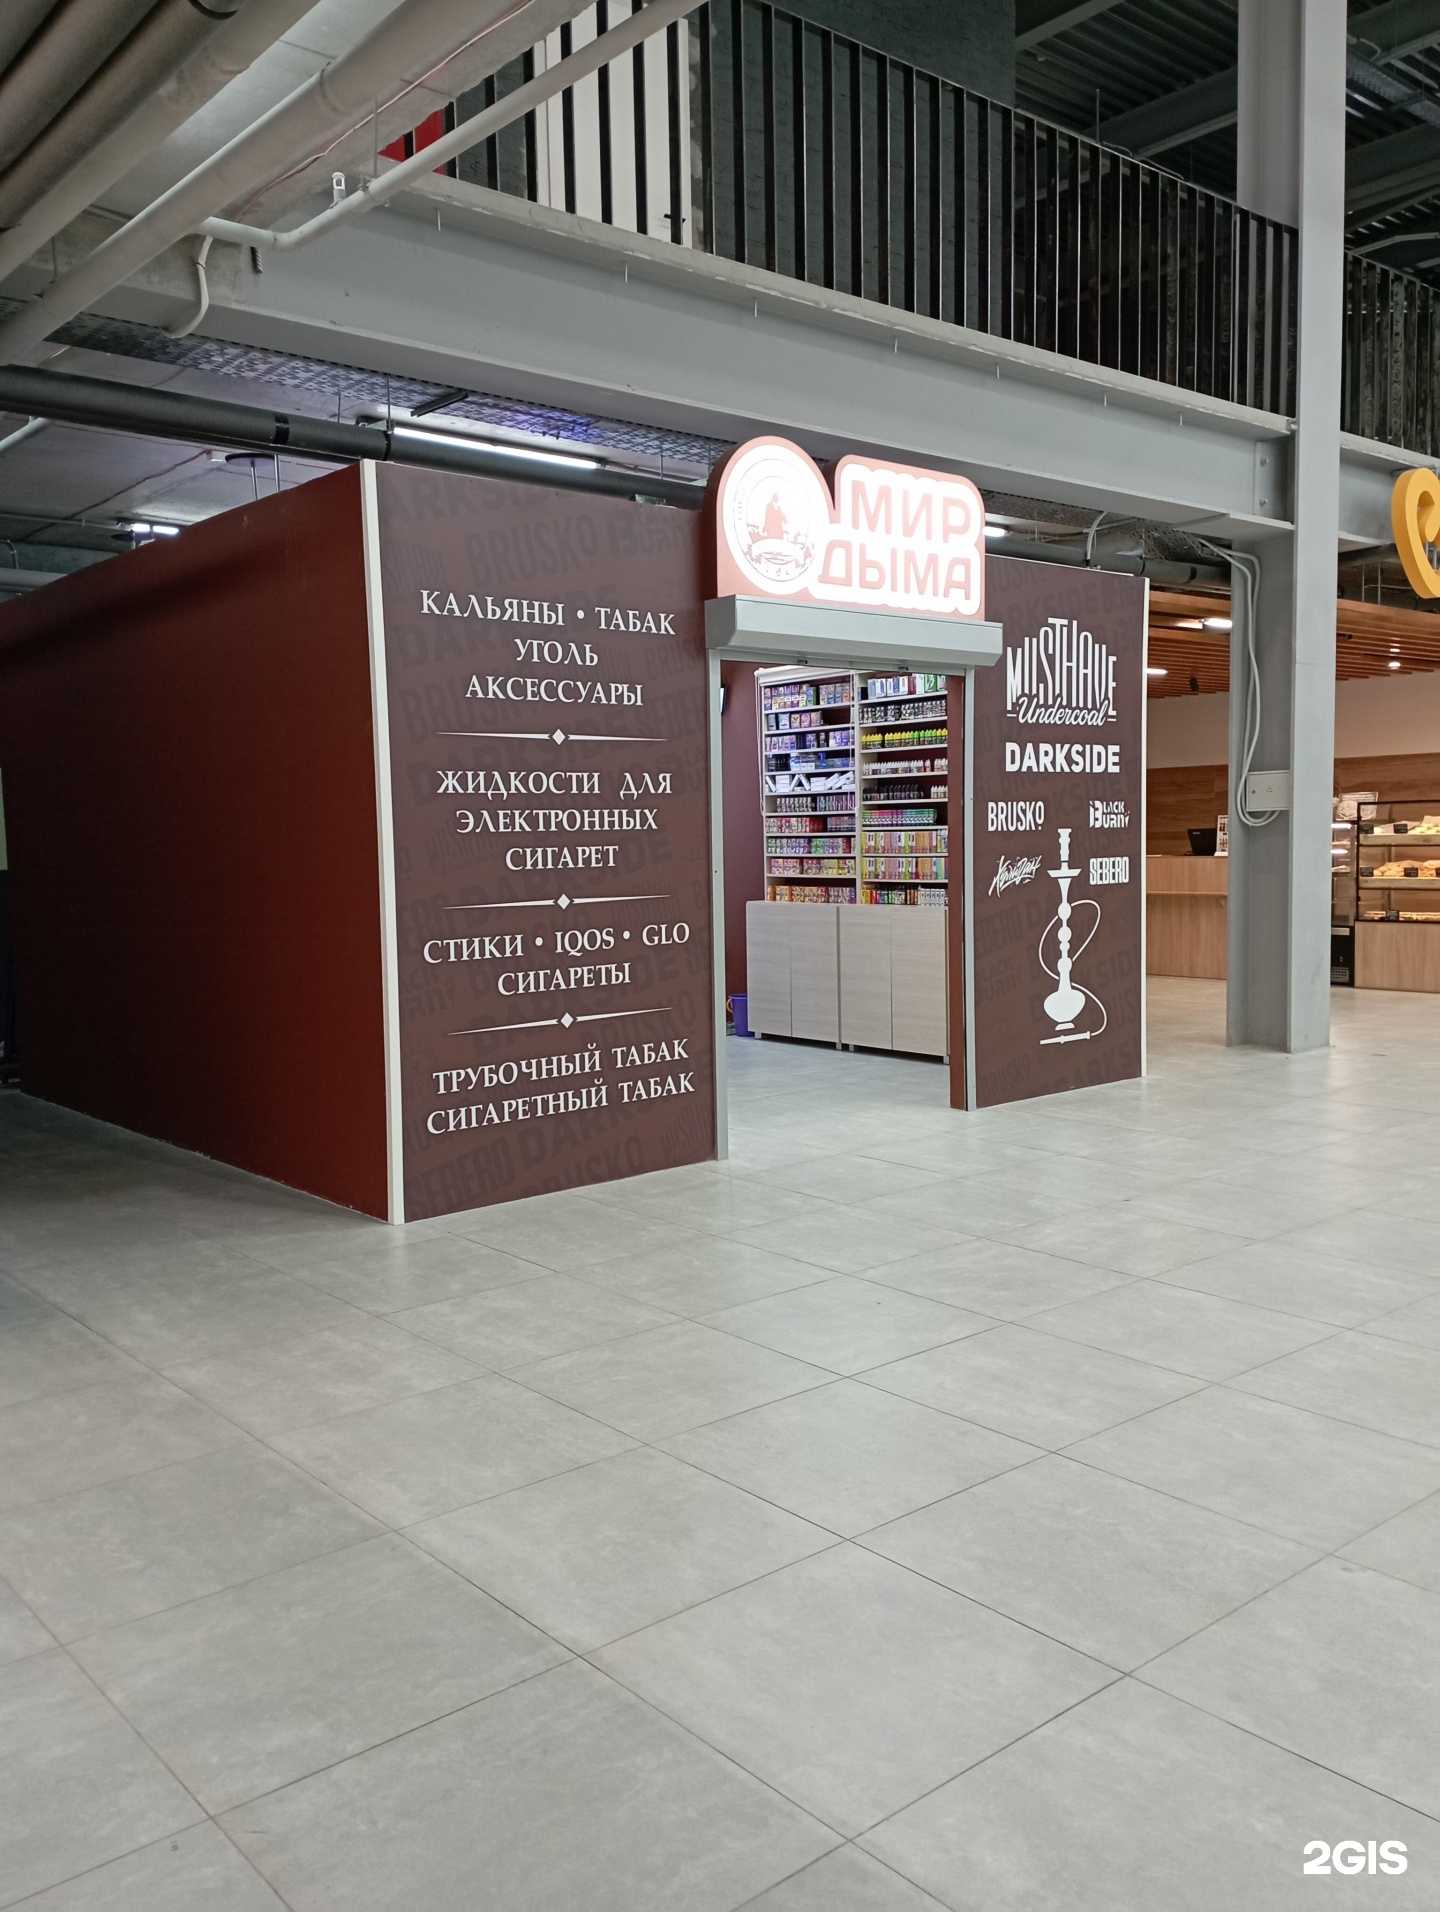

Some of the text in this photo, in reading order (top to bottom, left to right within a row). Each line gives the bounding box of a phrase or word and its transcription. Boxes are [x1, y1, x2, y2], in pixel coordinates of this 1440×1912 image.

[851, 479, 971, 544] МИР
[817, 539, 971, 601] ДЫМА
[421, 590, 675, 634] КАЛЬЯНЫ ТАБАК
[514, 639, 598, 665] УГОЛЬ
[466, 675, 643, 705] АКСЕССУАРЫ
[1018, 697, 1108, 726] Undercoal
[1006, 742, 1120, 773] DARKSIDE
[437, 771, 672, 800] ЖИДКОСТИ ДЛЯ
[457, 809, 657, 833] ЭЛЕКТРОННЫХ
[988, 801, 1044, 831] BRUSKO
[506, 846, 618, 870] СИГАРЕТ
[1090, 857, 1129, 885] SEBERO
[424, 923, 689, 963] СТИКИ IQOS GLO
[498, 963, 630, 995] СИГАРЕТЫ
[433, 1039, 688, 1094] ТРУБОЧНЫЙ ТАБАК
[427, 1078, 608, 1134] СИГАРЕТНЫЙ
[618, 1072, 694, 1102] ТАБАК
